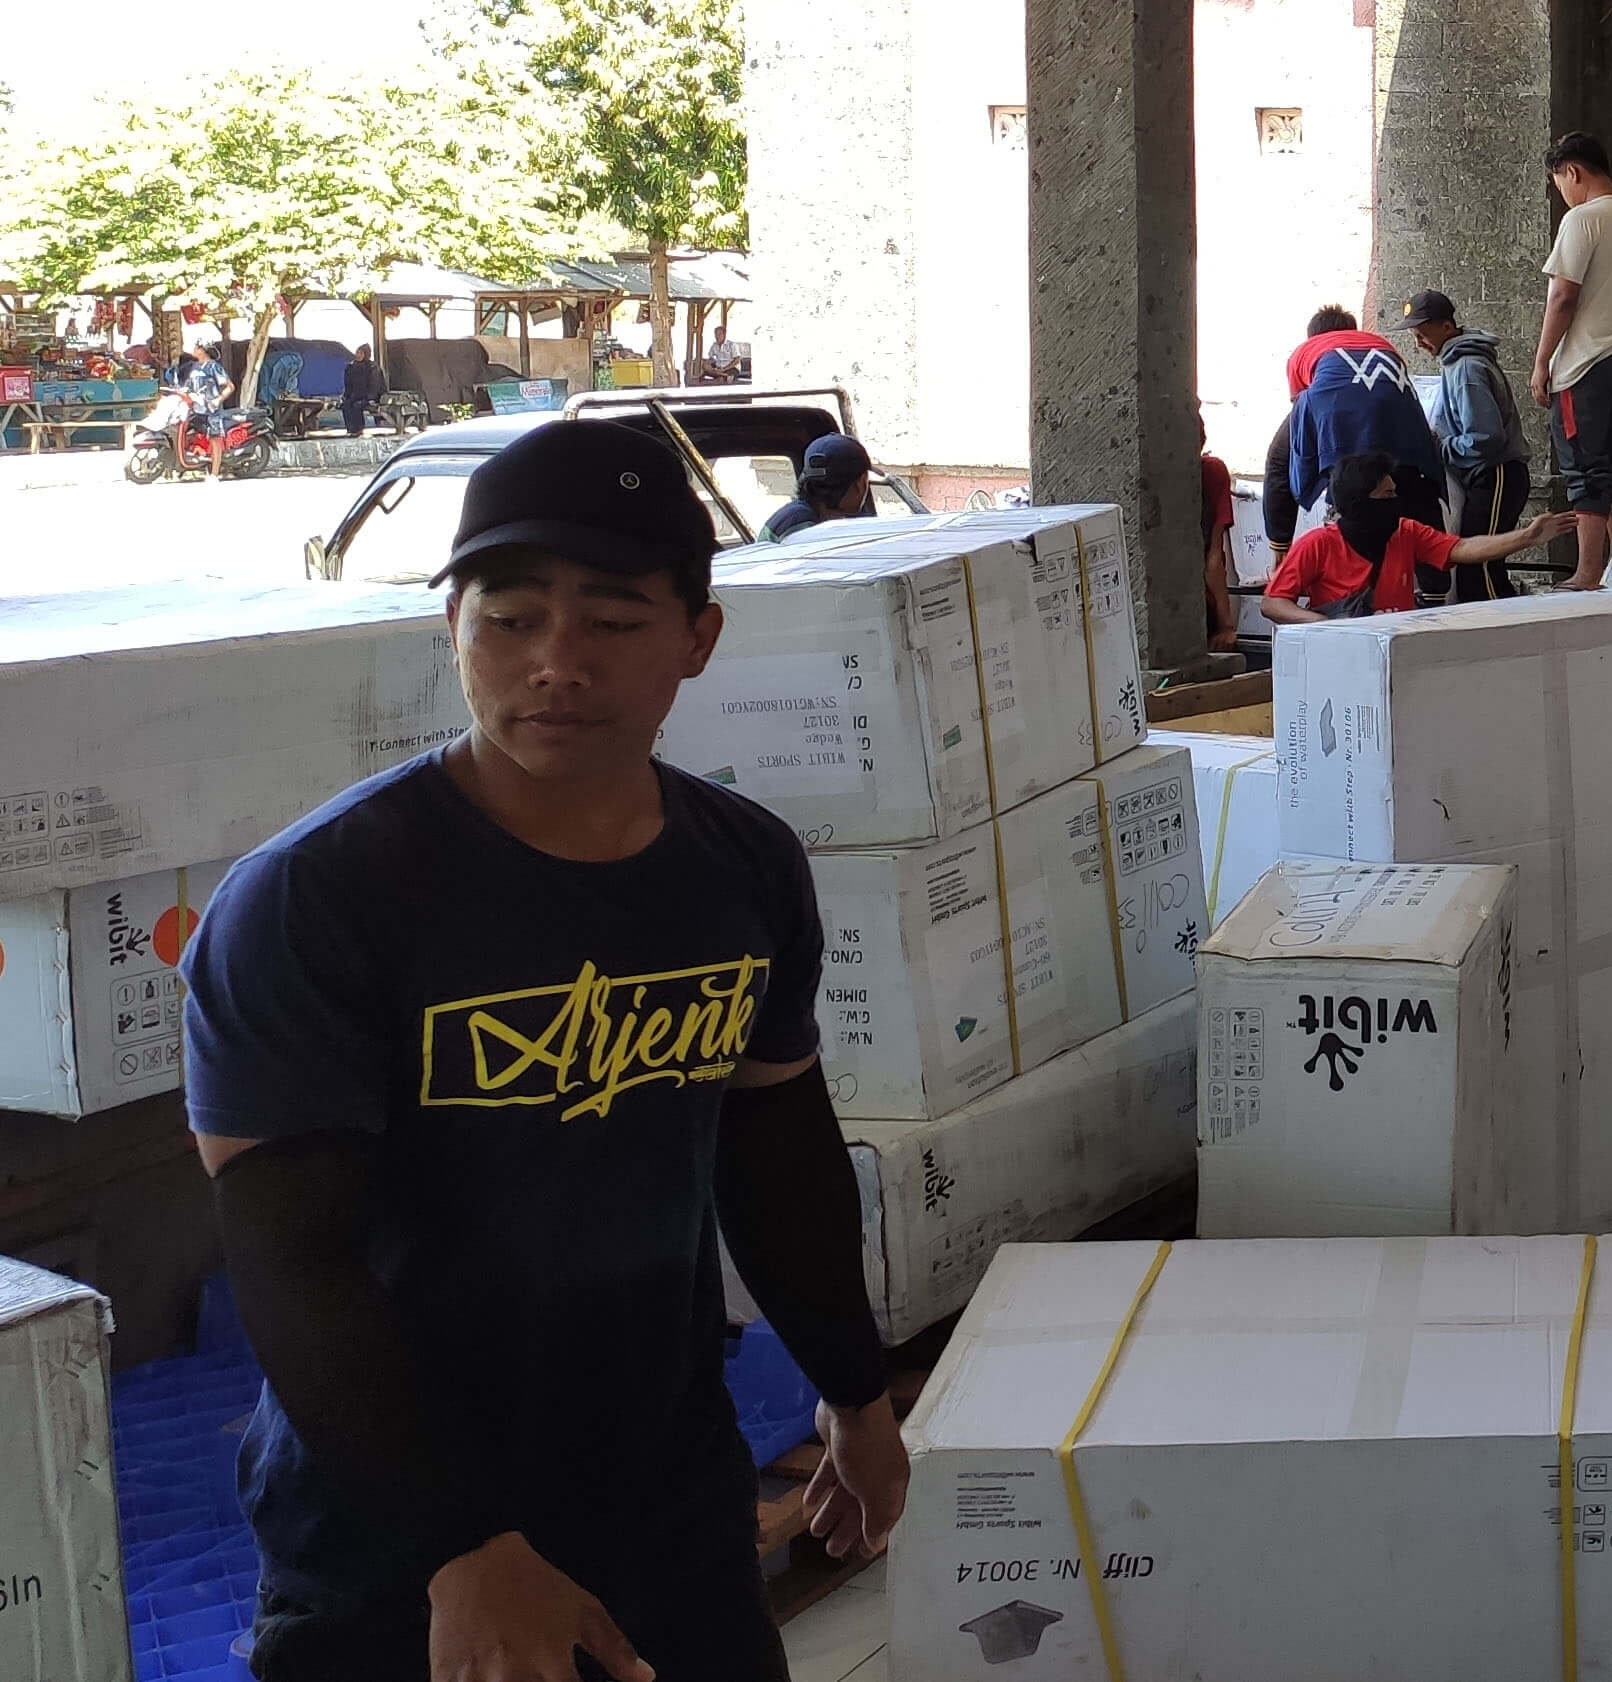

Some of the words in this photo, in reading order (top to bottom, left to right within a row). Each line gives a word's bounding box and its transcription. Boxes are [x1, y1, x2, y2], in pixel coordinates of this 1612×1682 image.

[803, 715, 840, 729] 30127
[1299, 699, 1309, 763] waterplay
[757, 754, 801, 769] SPORTS
[1288, 720, 1298, 785] evolution
[1345, 824, 1354, 862] onnect
[107, 893, 126, 966] wibit
[826, 988, 867, 1002] DIMEN
[1298, 994, 1438, 1043] wibit
[957, 1559, 1040, 1584] 30014
[1050, 1557, 1081, 1580] Nr.
[1102, 1553, 1154, 1580] Cliff
